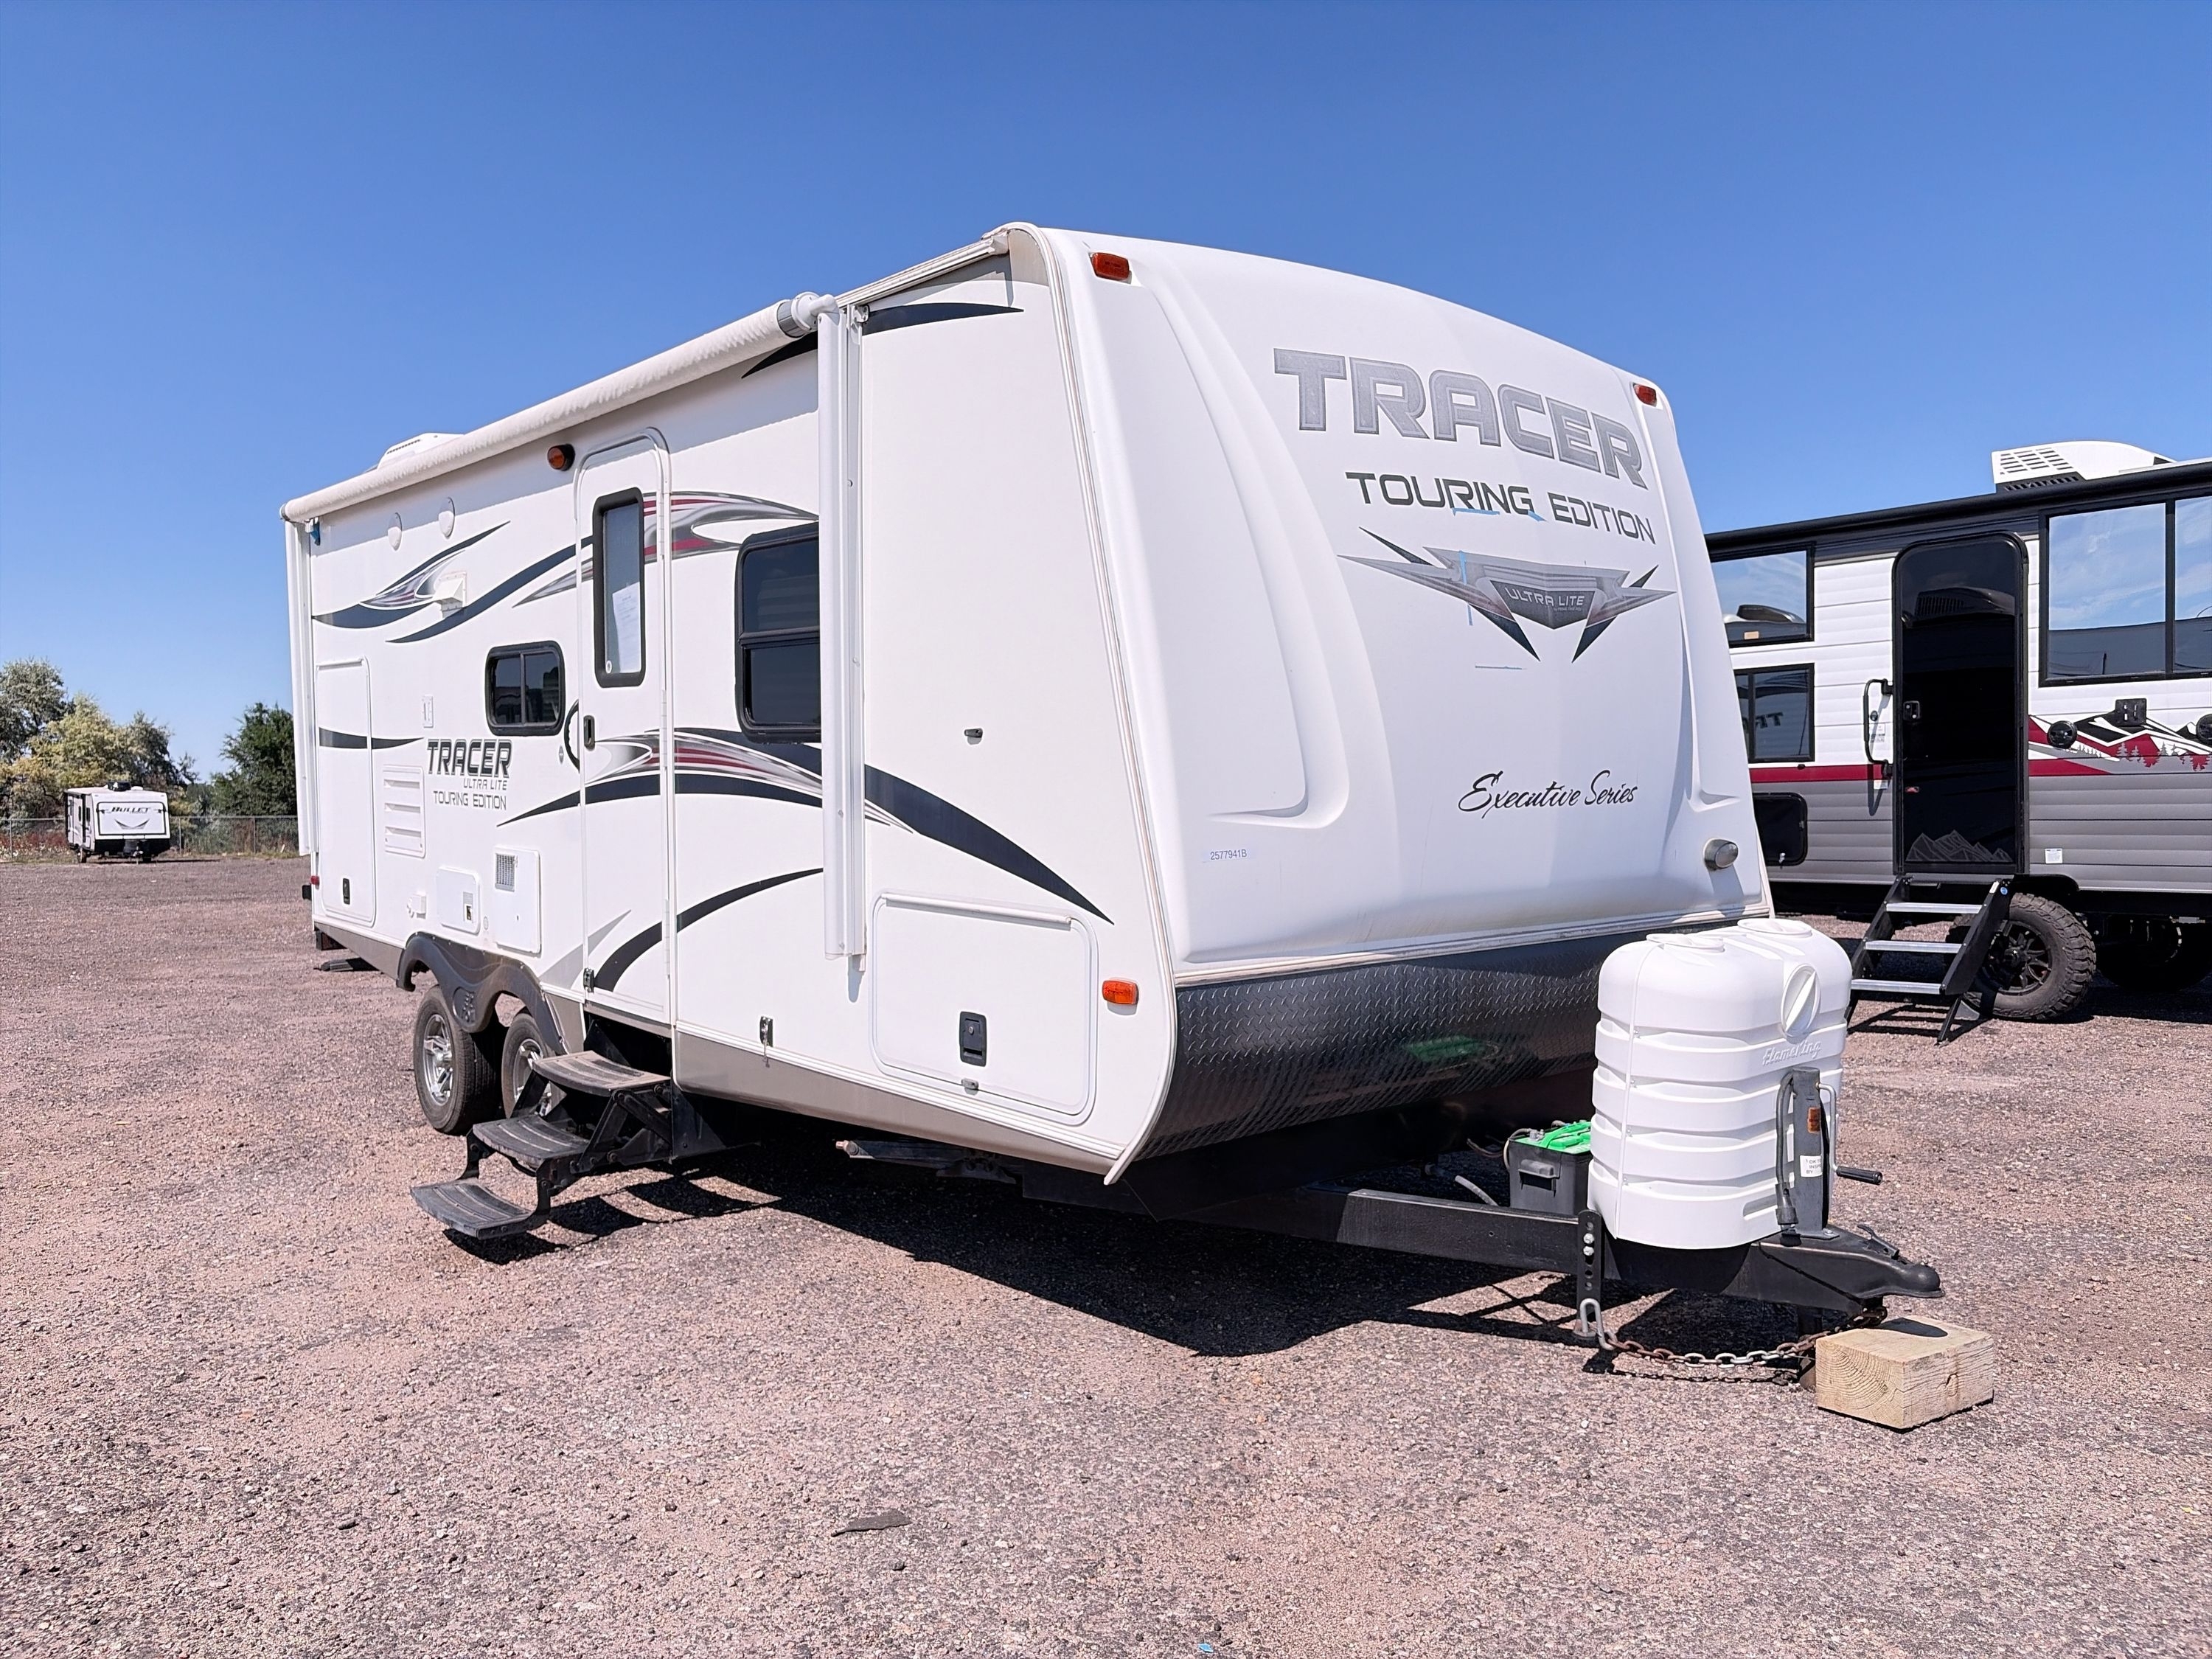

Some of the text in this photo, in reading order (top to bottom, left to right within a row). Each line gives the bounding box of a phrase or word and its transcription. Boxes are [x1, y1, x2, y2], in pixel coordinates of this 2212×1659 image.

[1274, 348, 1649, 490] TRACER
[1346, 472, 1656, 545] TOURING EDITION
[1505, 587, 1585, 607] ULTRA LITE
[427, 738, 512, 779] TRACER
[463, 778, 507, 790] ULTRA LITE
[1458, 770, 1638, 819] Executive Series
[434, 790, 507, 810] TOURING EDITION
[1210, 849, 1248, 860] 2577941B
